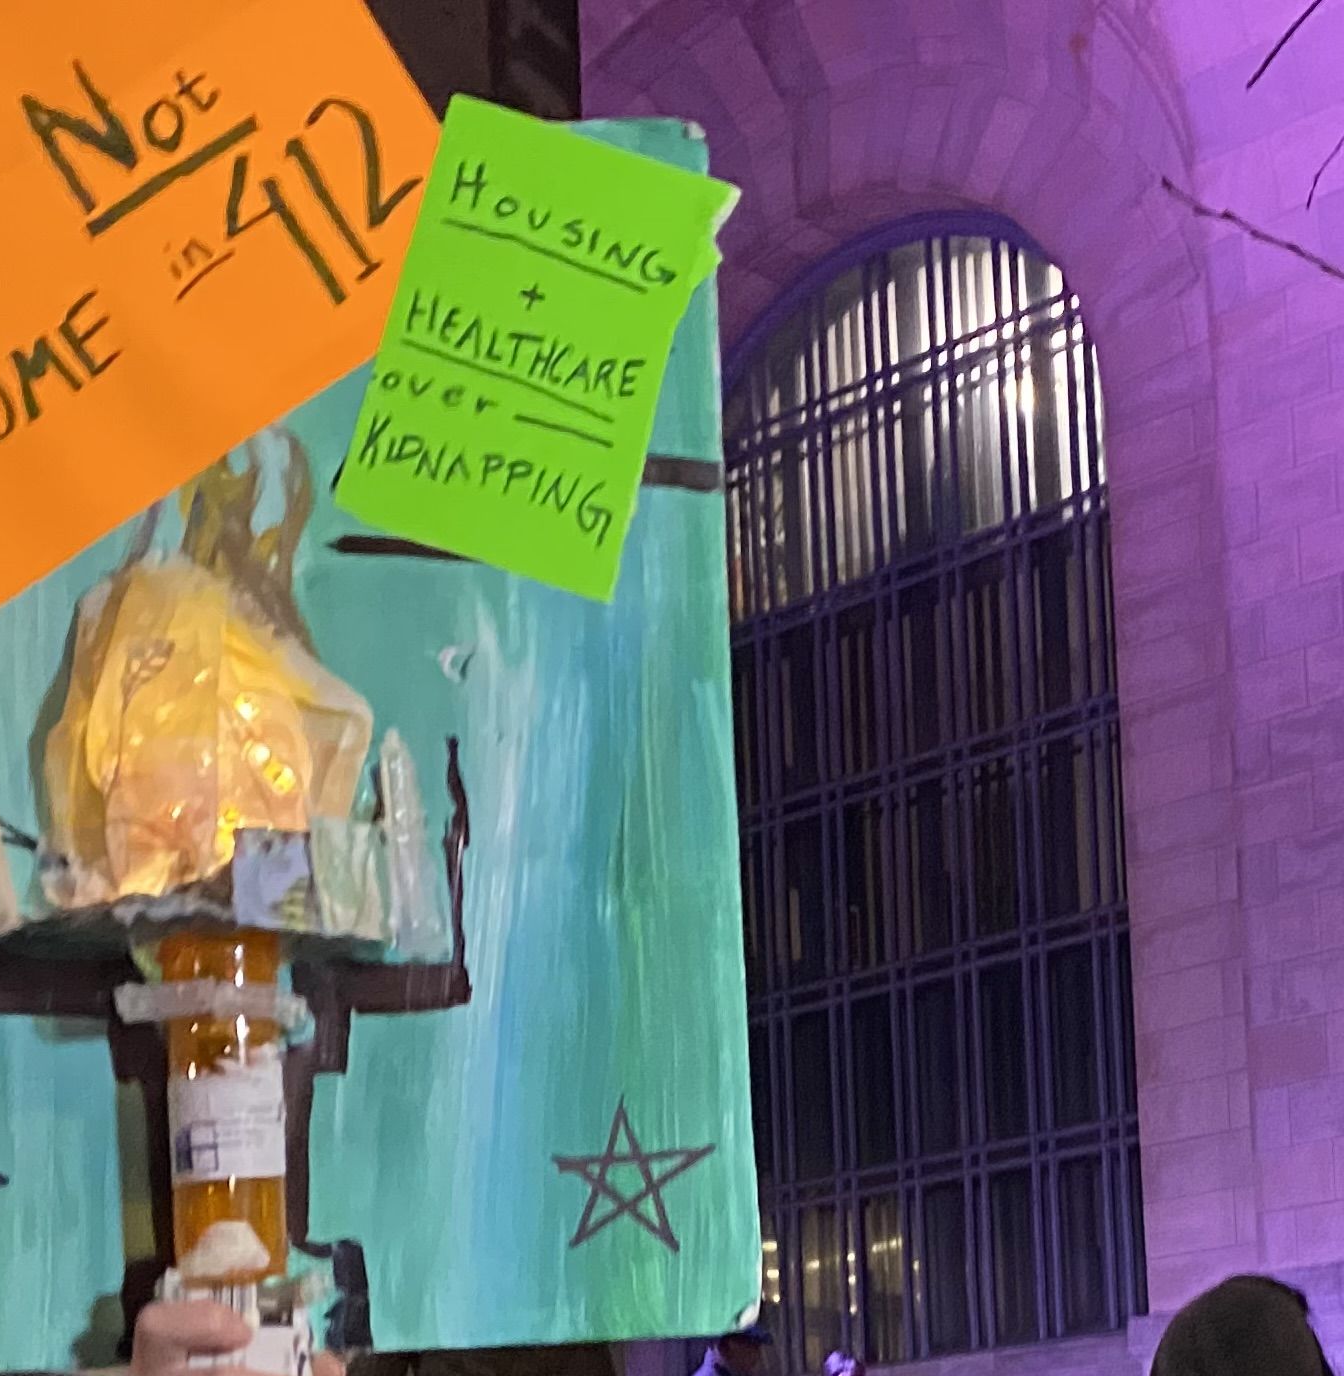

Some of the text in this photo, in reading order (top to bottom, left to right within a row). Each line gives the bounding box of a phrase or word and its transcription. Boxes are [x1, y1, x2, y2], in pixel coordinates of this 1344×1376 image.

[20, 58, 220, 214] Not
[164, 240, 214, 280] in
[224, 97, 425, 305] 412
[380, 370, 497, 416] over
[406, 287, 647, 399] HEALTHCARE
[358, 411, 613, 552] KIDNAPPING
